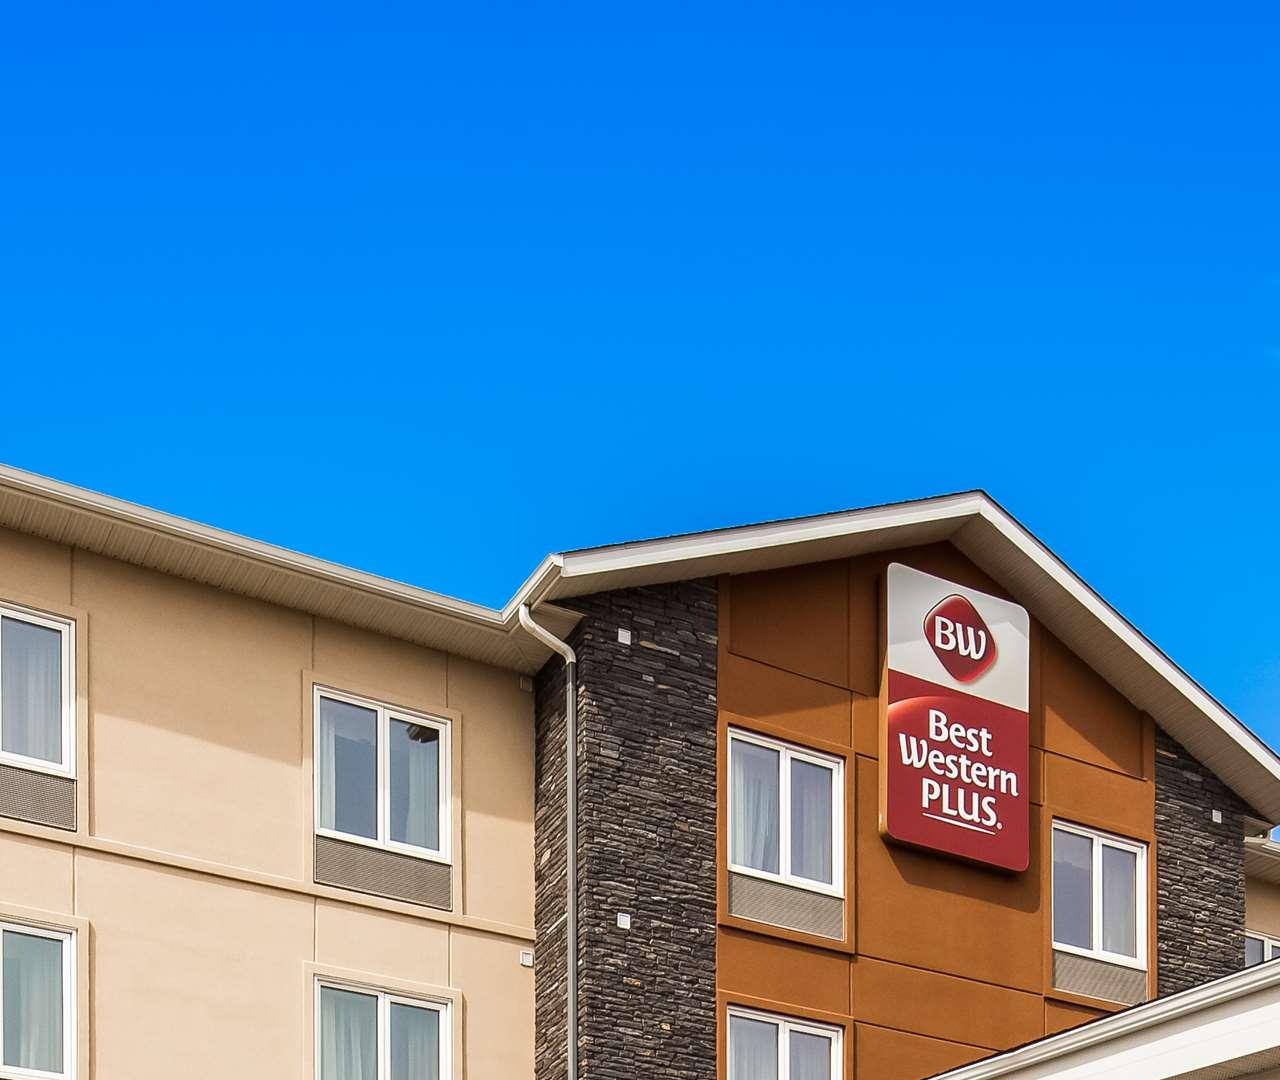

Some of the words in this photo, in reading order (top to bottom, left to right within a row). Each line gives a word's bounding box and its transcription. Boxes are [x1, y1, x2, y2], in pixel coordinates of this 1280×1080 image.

[935, 615, 986, 660] BW
[929, 709, 993, 757] Best
[898, 733, 1019, 797] Western
